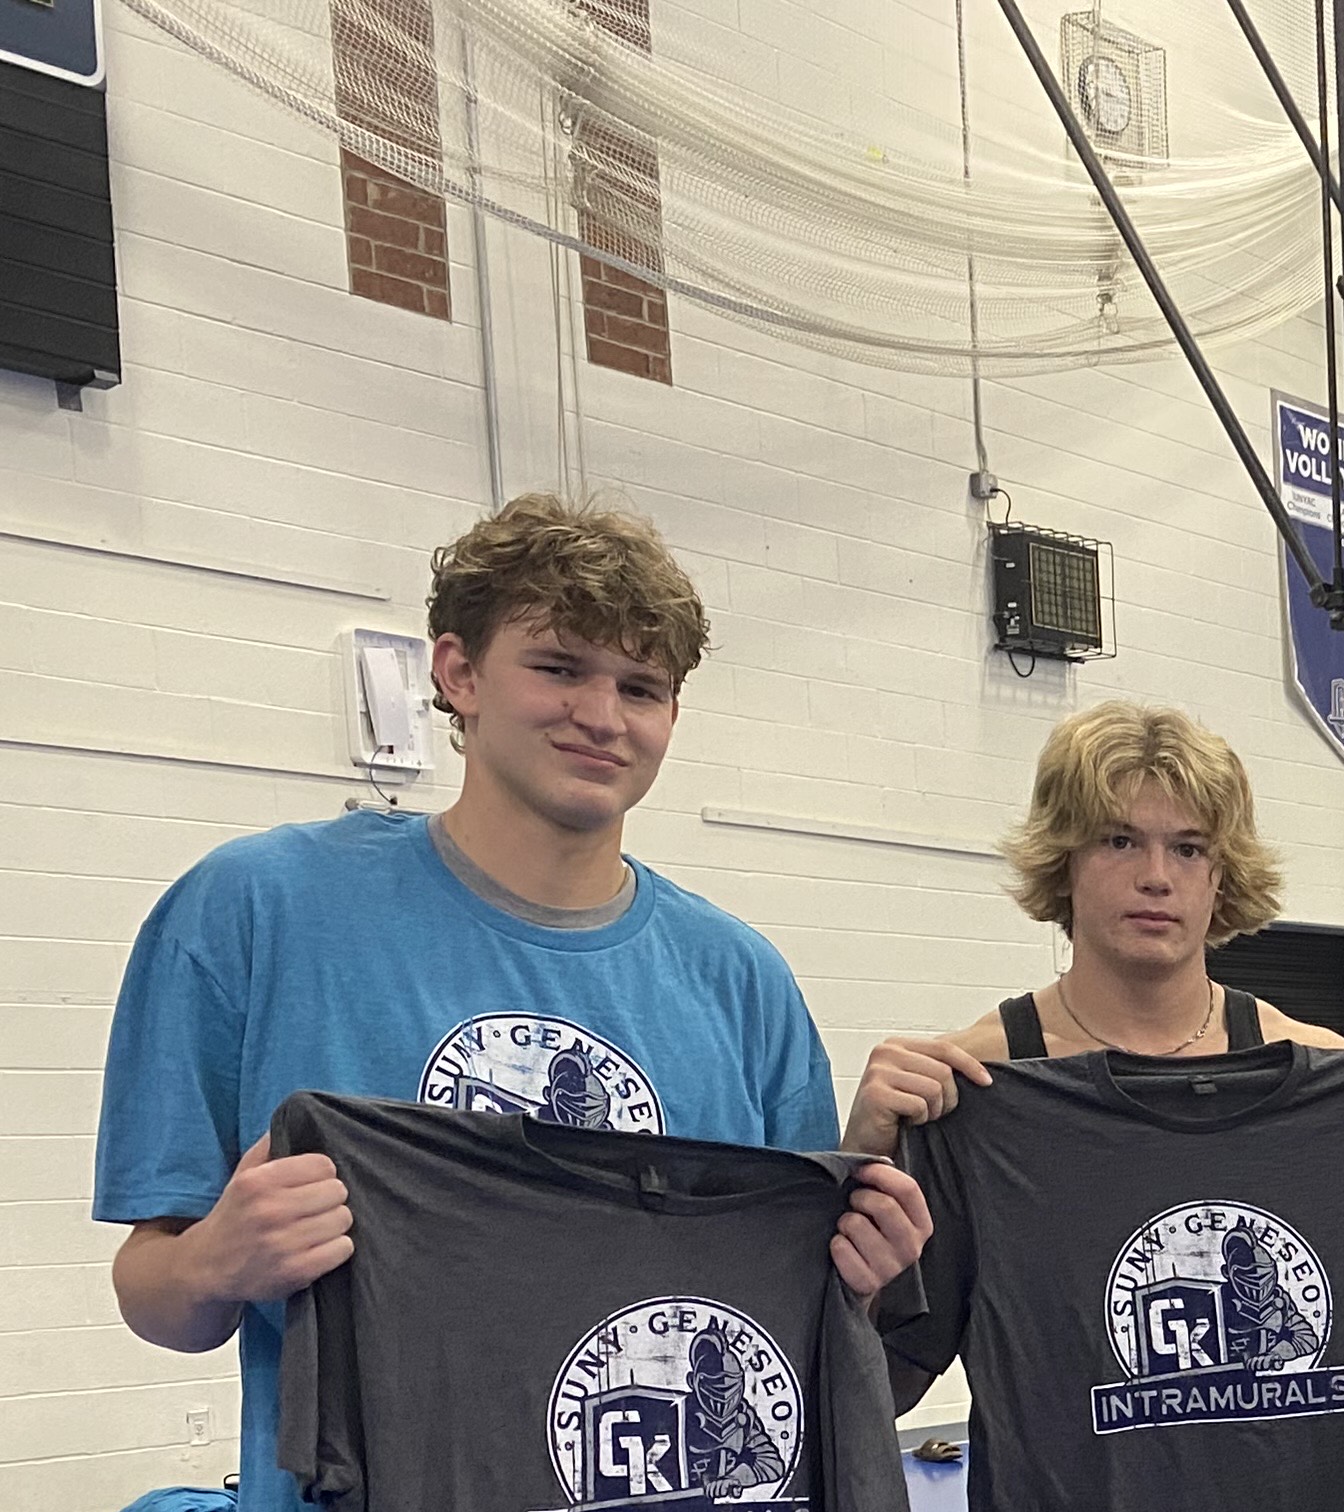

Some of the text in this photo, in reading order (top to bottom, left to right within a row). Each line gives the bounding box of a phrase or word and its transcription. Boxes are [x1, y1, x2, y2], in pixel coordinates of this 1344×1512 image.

[428, 1025, 653, 1135] SUNY GENESE
[1113, 1212, 1321, 1317] SUNY GENESEO
[557, 1310, 793, 1431] SUNY GENESEO
